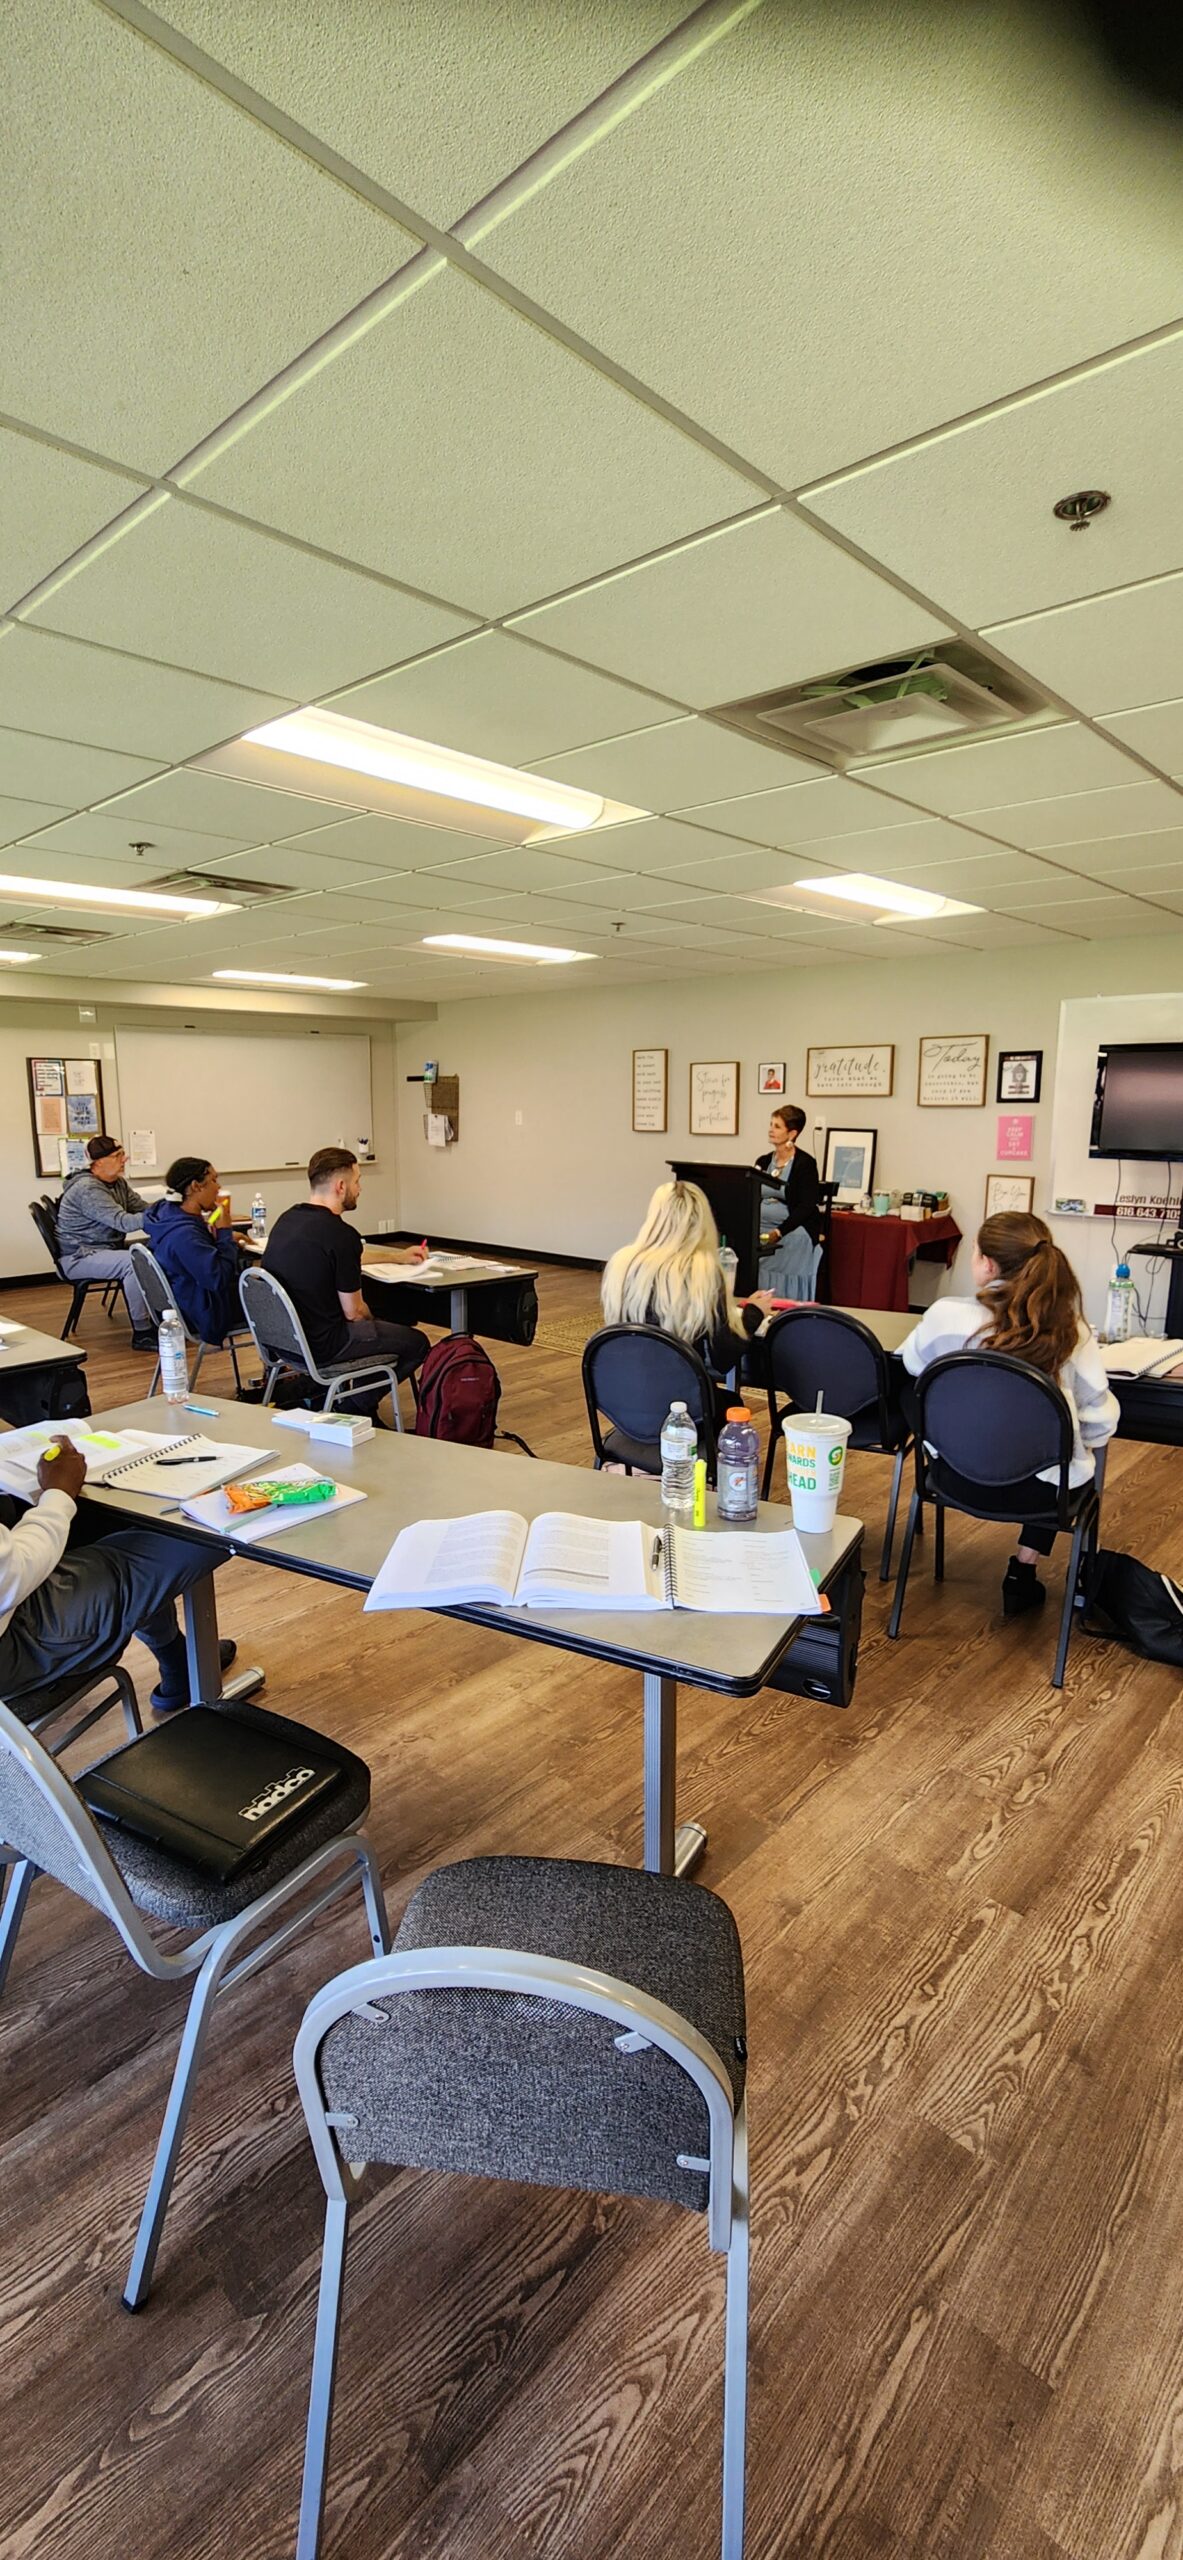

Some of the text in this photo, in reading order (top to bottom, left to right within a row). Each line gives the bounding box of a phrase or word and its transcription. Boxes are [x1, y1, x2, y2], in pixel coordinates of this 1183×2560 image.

[924, 1041, 981, 1072] Today
[1117, 1194, 1180, 1206] eslyn Koehl
